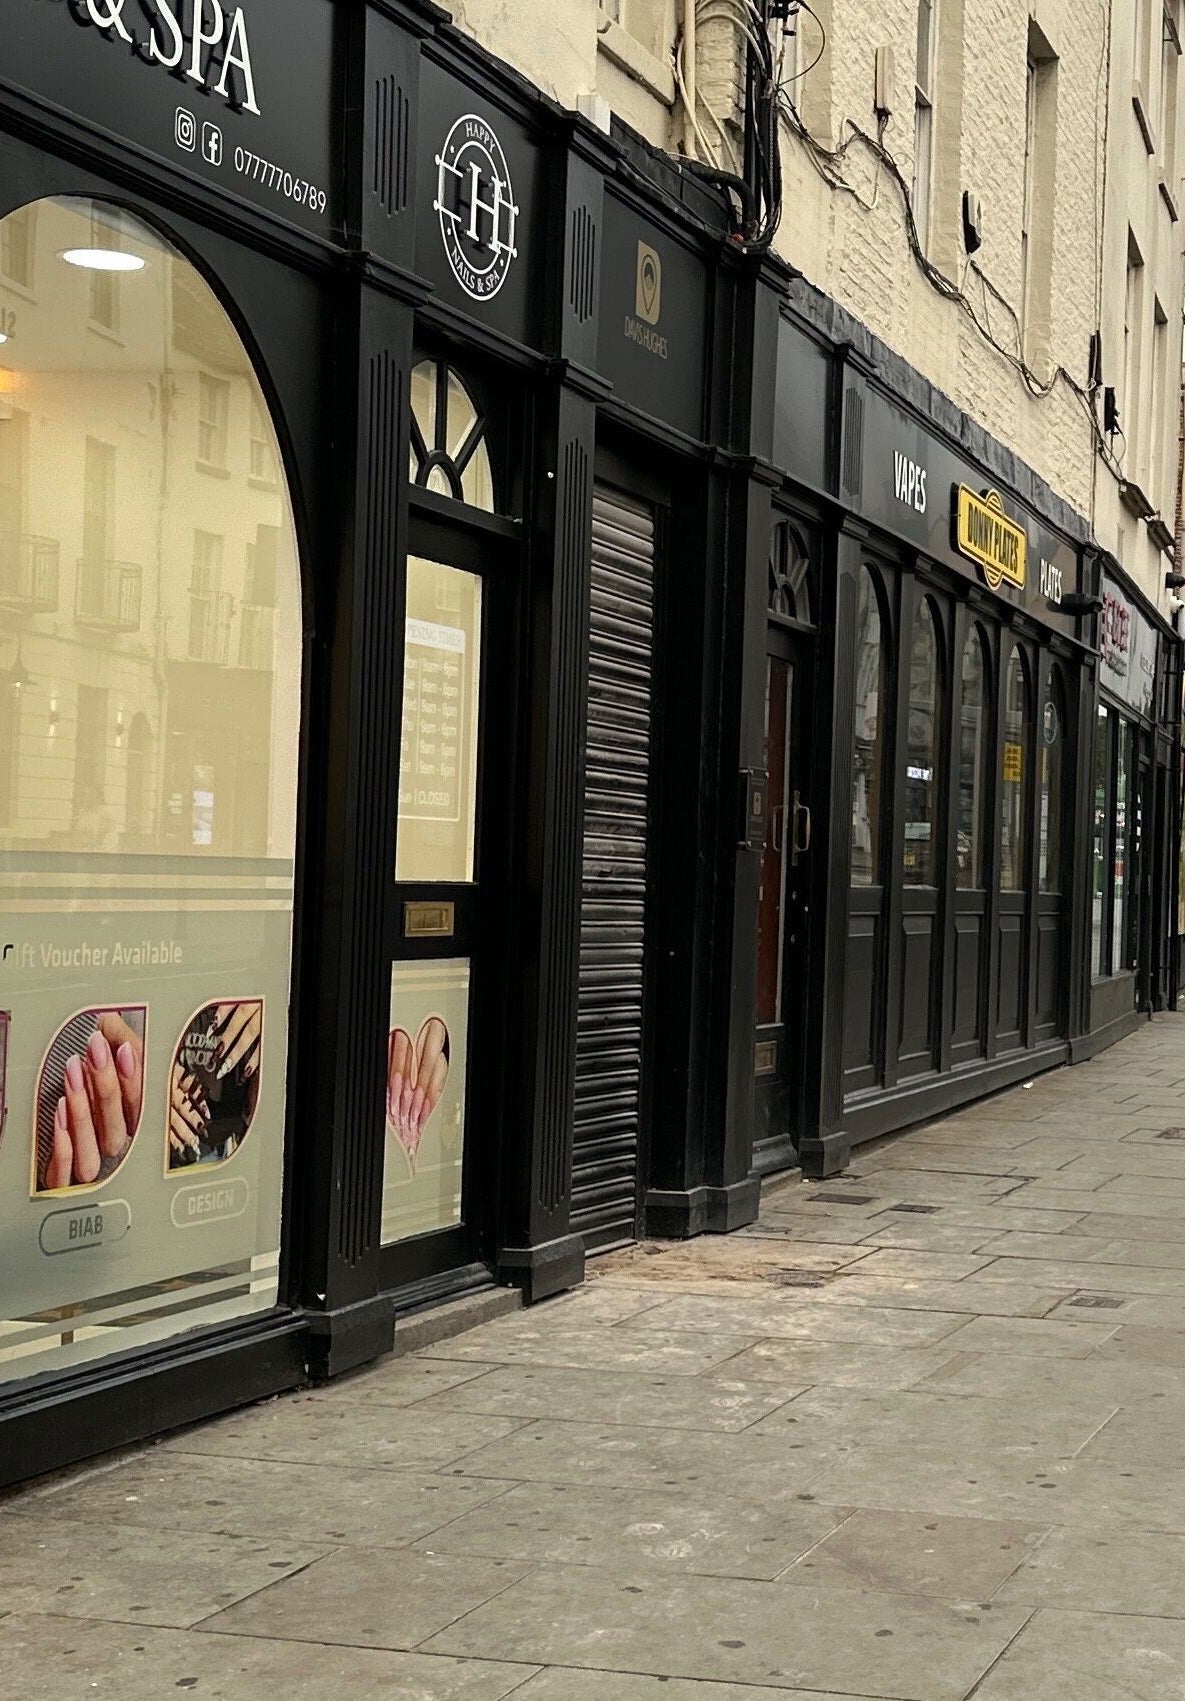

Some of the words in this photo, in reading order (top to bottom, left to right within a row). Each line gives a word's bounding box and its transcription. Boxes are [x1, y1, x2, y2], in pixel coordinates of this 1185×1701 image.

[150, 0, 261, 116] SPA
[465, 121, 496, 154] HAPPY
[234, 142, 327, 214] 07777706789
[451, 246, 475, 289] NAILS
[477, 277, 485, 292] &
[485, 269, 500, 291] SPA
[894, 450, 927, 514] VAPES
[1040, 558, 1063, 605] PLATES
[39, 942, 109, 968] Voucher
[111, 940, 184, 965] Available
[187, 1188, 234, 1216] DESIGN
[68, 1214, 104, 1241] BIAB
